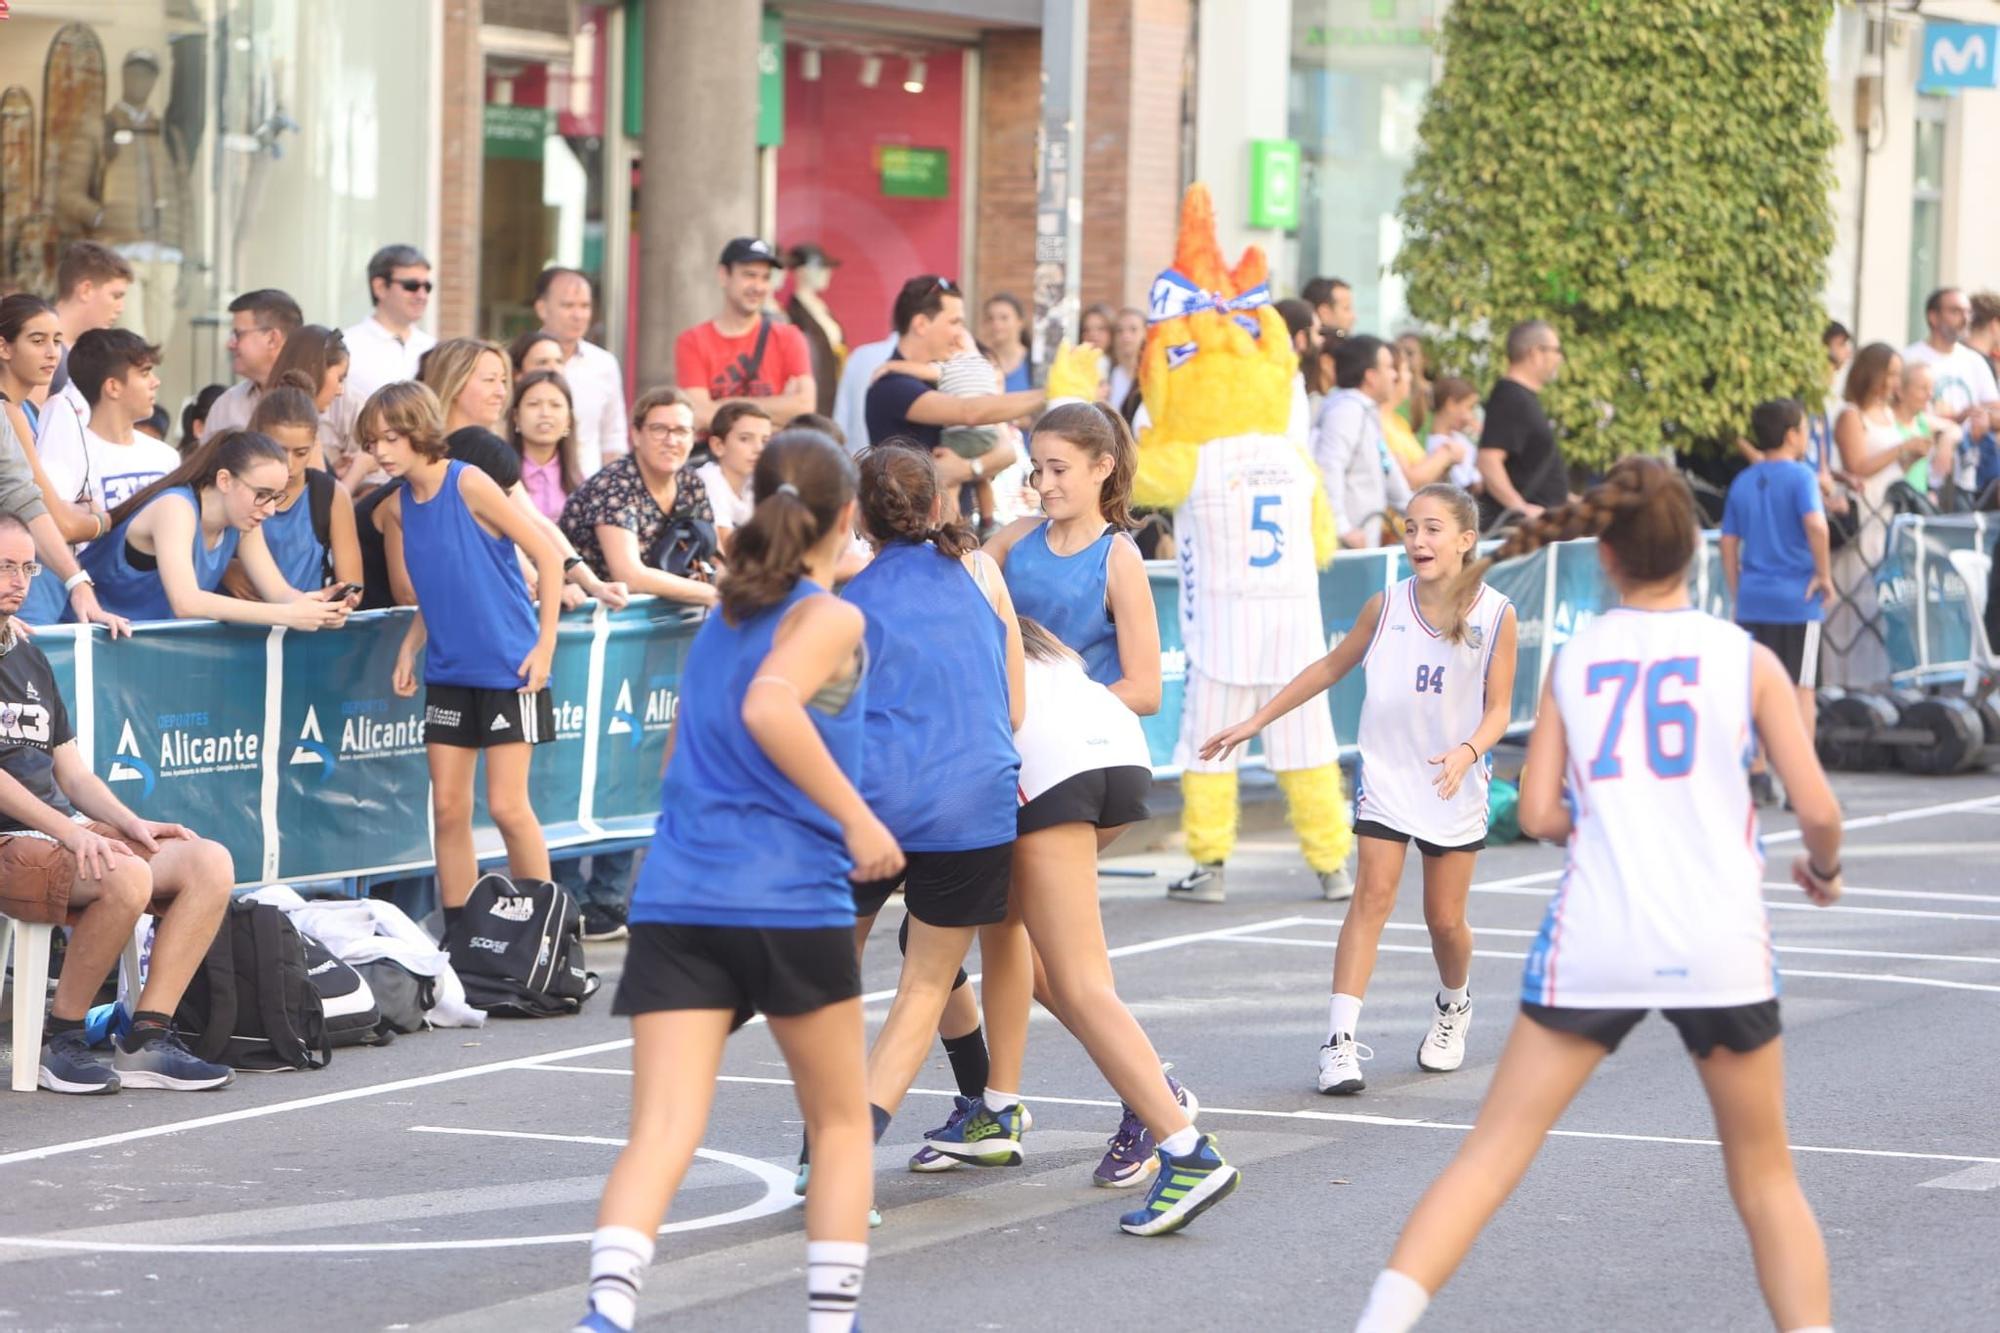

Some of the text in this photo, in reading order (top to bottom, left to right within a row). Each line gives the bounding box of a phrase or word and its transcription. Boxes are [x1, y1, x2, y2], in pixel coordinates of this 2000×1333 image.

[1249, 495, 1283, 567] 5
[1416, 664, 1445, 694] 84
[157, 711, 210, 729] DEPORTES
[1585, 657, 1700, 781] 76
[160, 728, 259, 769] Alicante
